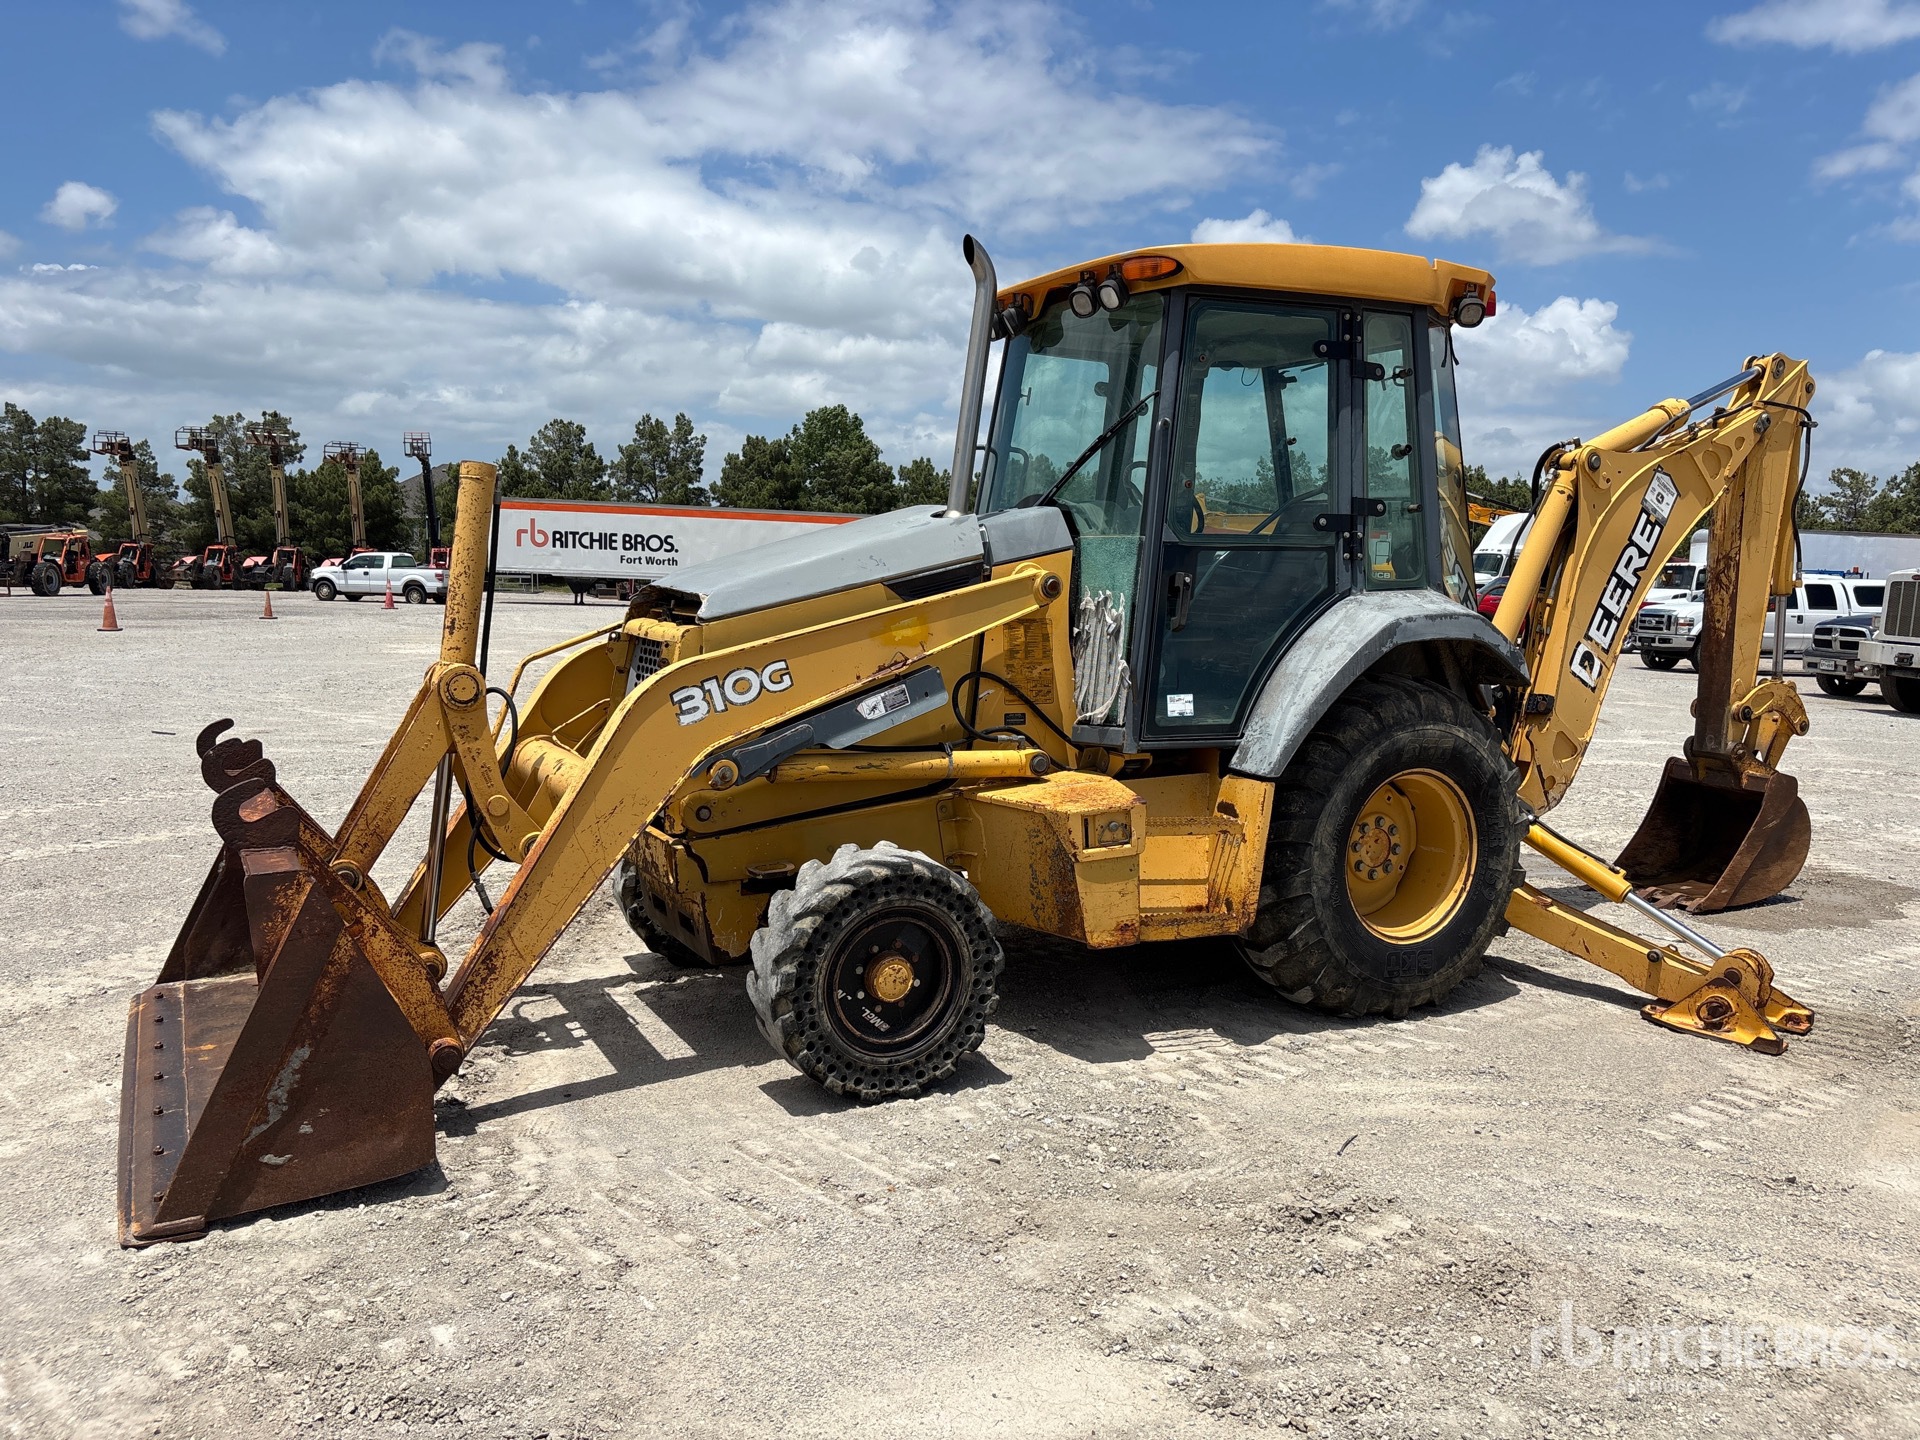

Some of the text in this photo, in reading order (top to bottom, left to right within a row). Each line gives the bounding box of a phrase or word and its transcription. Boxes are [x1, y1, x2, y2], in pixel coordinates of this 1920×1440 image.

[23, 541, 34, 549] JLG
[516, 518, 679, 553] rb RITCHIE BROS.
[620, 555, 678, 566] Fort Worth
[1571, 513, 1661, 688] DEERE
[670, 660, 793, 726] 310G
